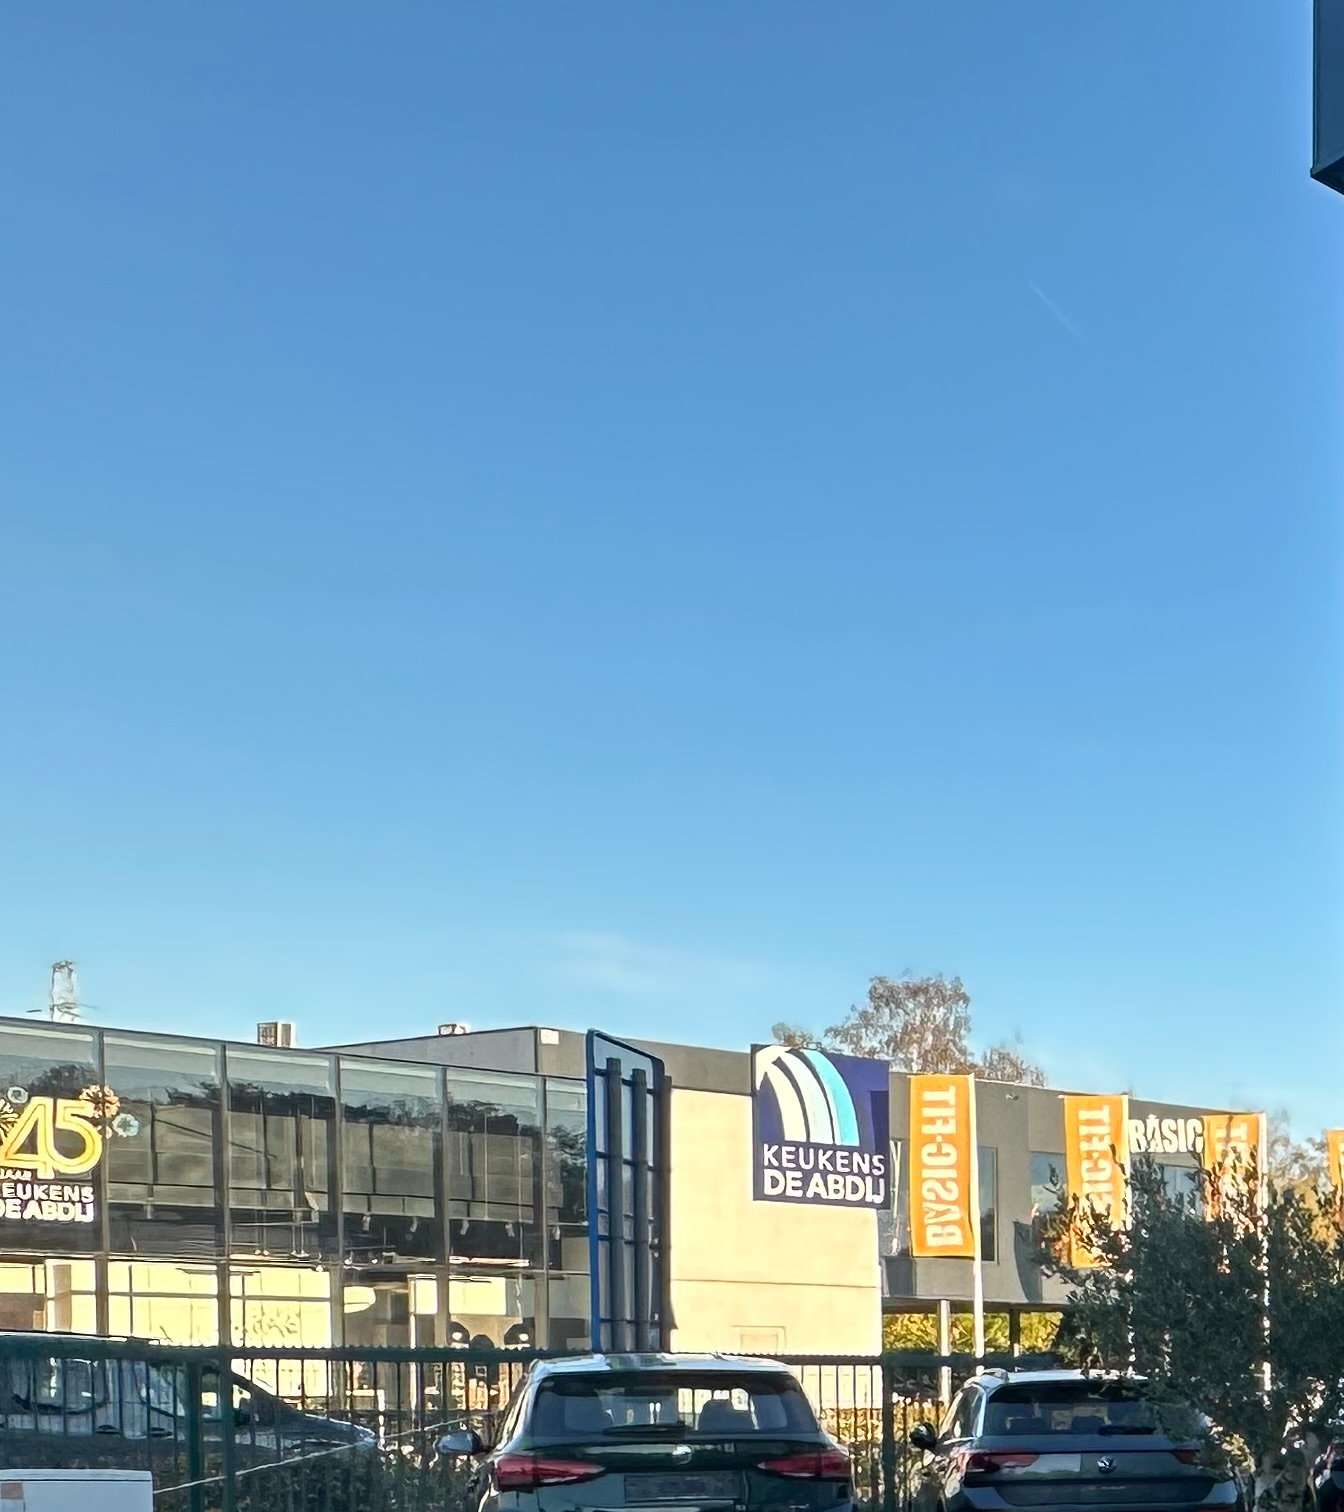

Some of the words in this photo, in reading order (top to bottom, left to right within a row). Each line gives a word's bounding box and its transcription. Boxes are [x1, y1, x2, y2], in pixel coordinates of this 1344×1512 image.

[0, 1096, 102, 1179] 45
[1128, 1114, 1204, 1153] BASIC
[763, 1143, 885, 1176] KEUKENS
[0, 1182, 94, 1203] EUKENS
[805, 1172, 885, 1204] ABDIJ
